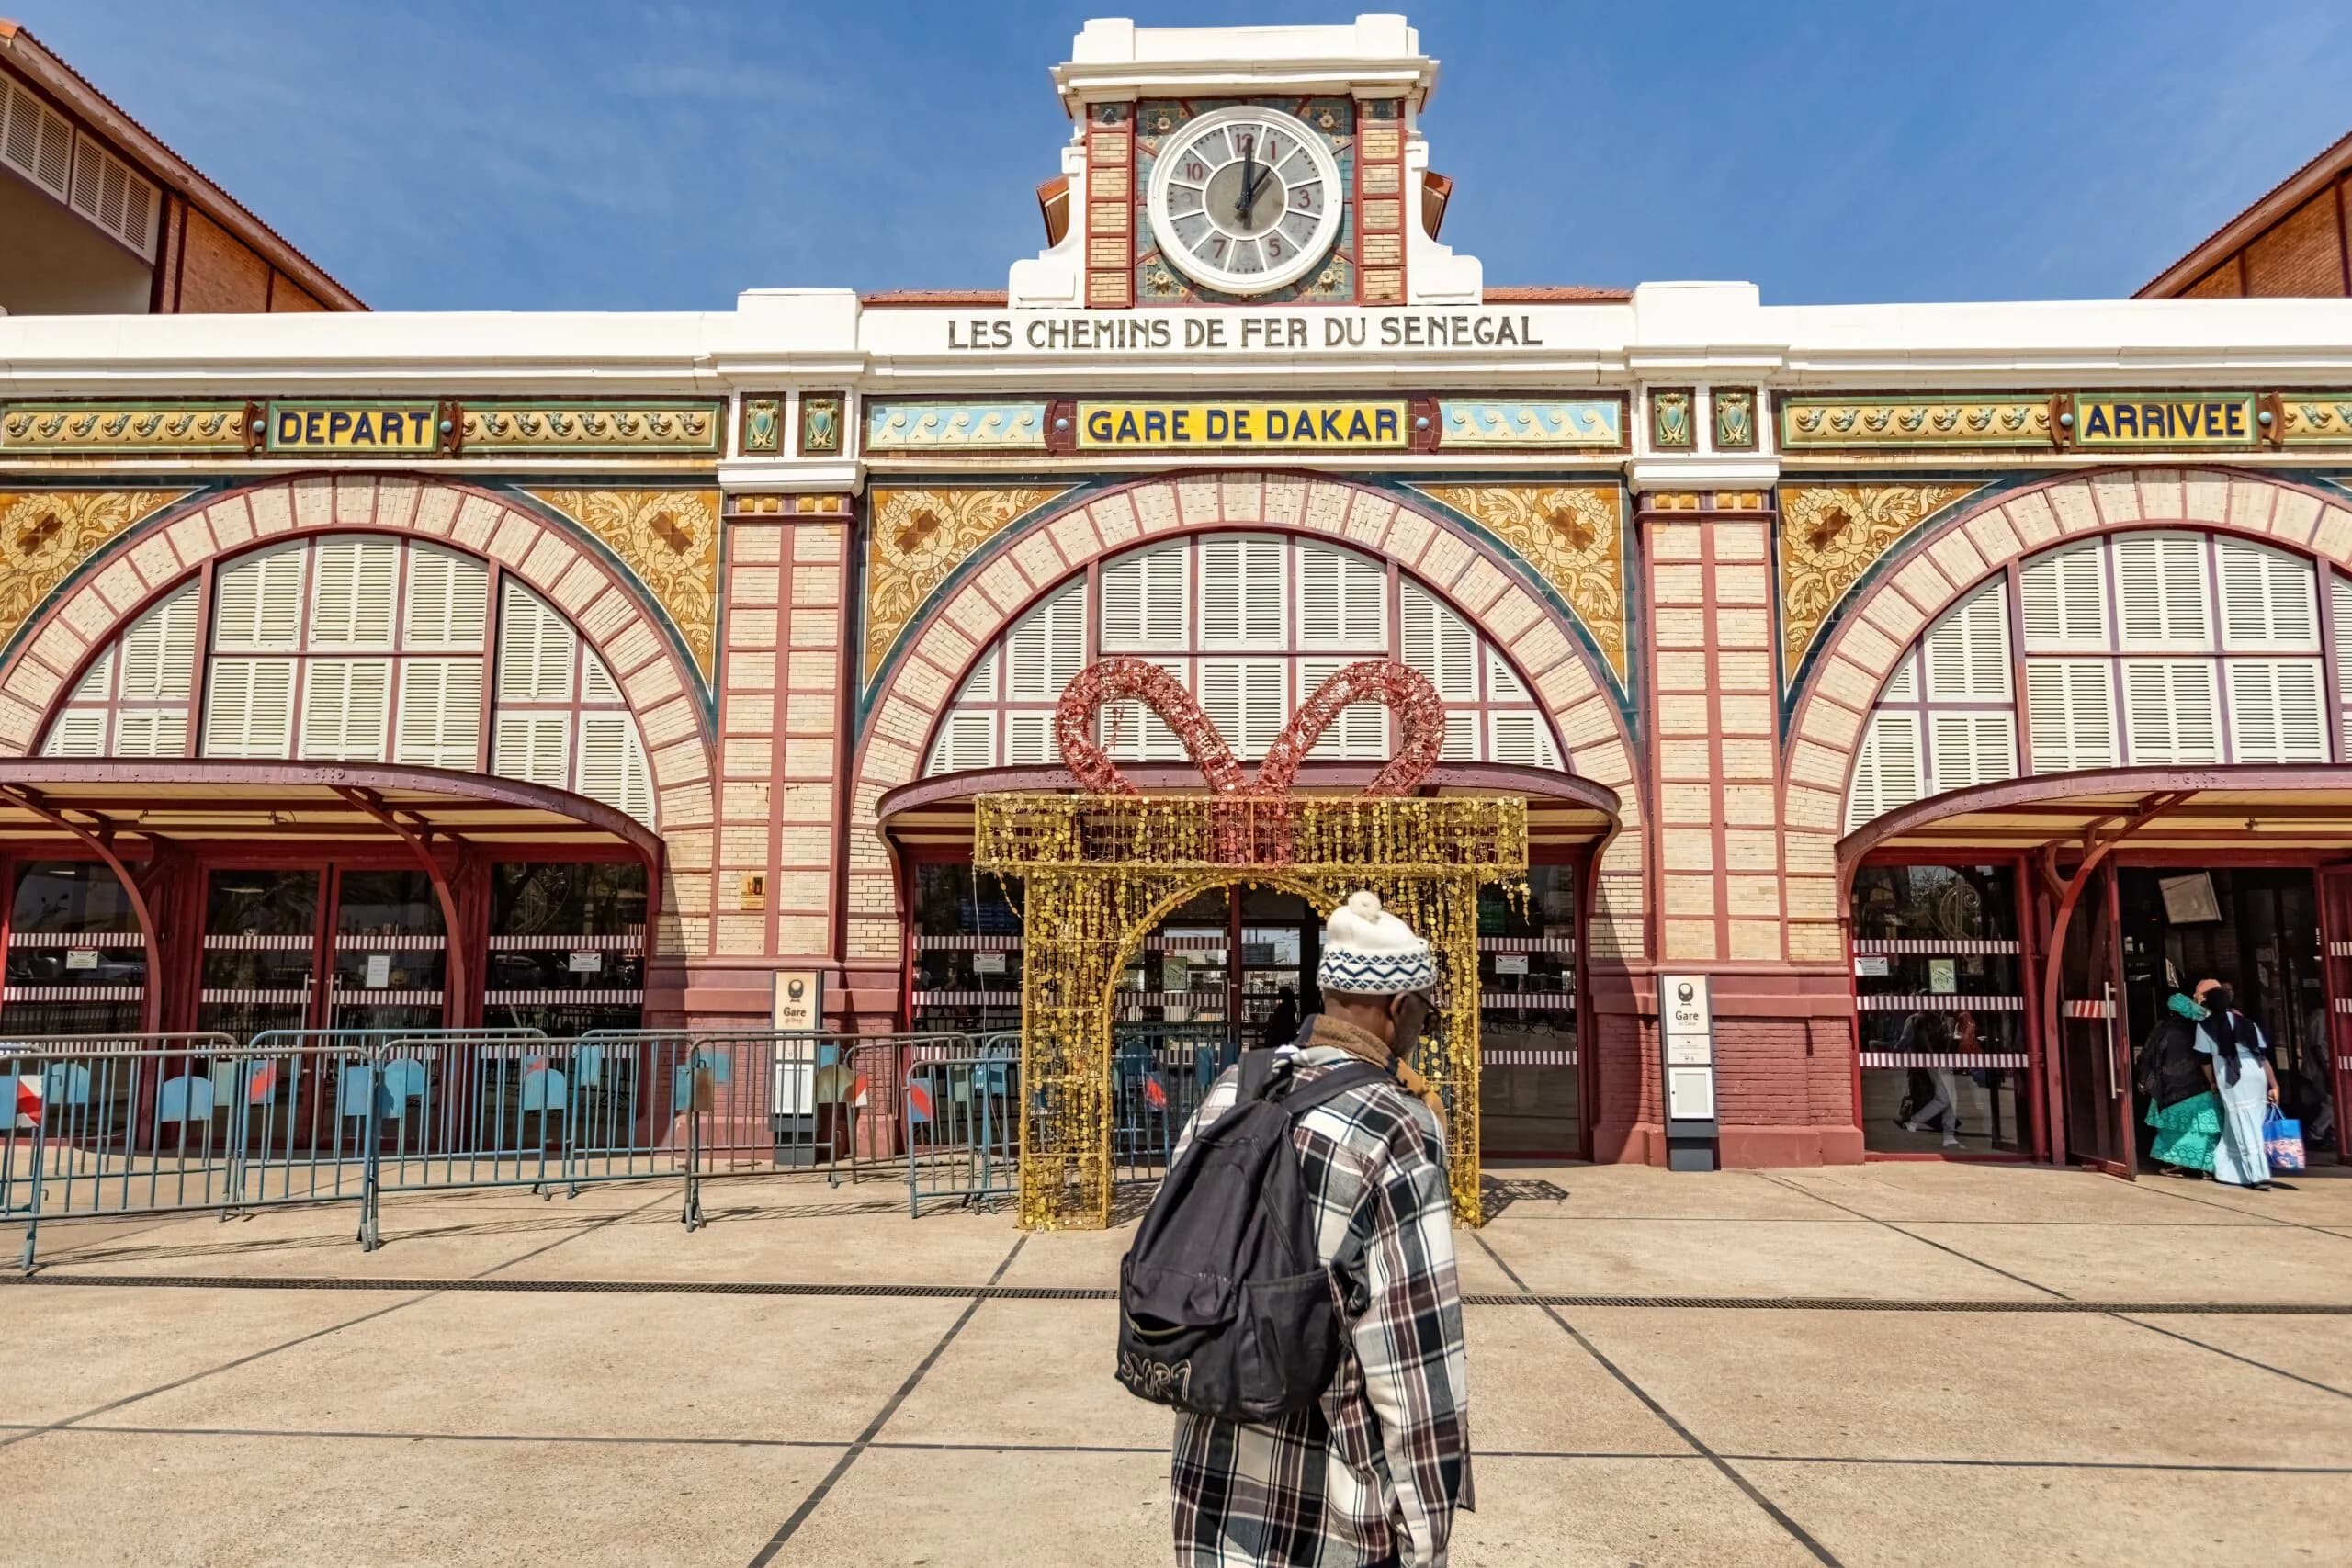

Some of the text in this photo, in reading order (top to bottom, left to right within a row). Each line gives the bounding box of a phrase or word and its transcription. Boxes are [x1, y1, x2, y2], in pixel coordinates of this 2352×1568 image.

[1269, 141, 1276, 160] 1
[1186, 163, 1204, 181] 10
[1297, 189, 1311, 209] 3
[1212, 239, 1227, 259] 7
[1269, 238, 1281, 258] 5
[948, 316, 1544, 350] LES CHEMINS DE FER DU SENEGAL
[277, 412, 432, 445] DEPART
[1087, 407, 1398, 442] GARE DE DAKAR
[2085, 403, 2245, 438] ARRIVEE
[784, 1007, 807, 1017] Gare
[1675, 1010, 1699, 1021] Gare
